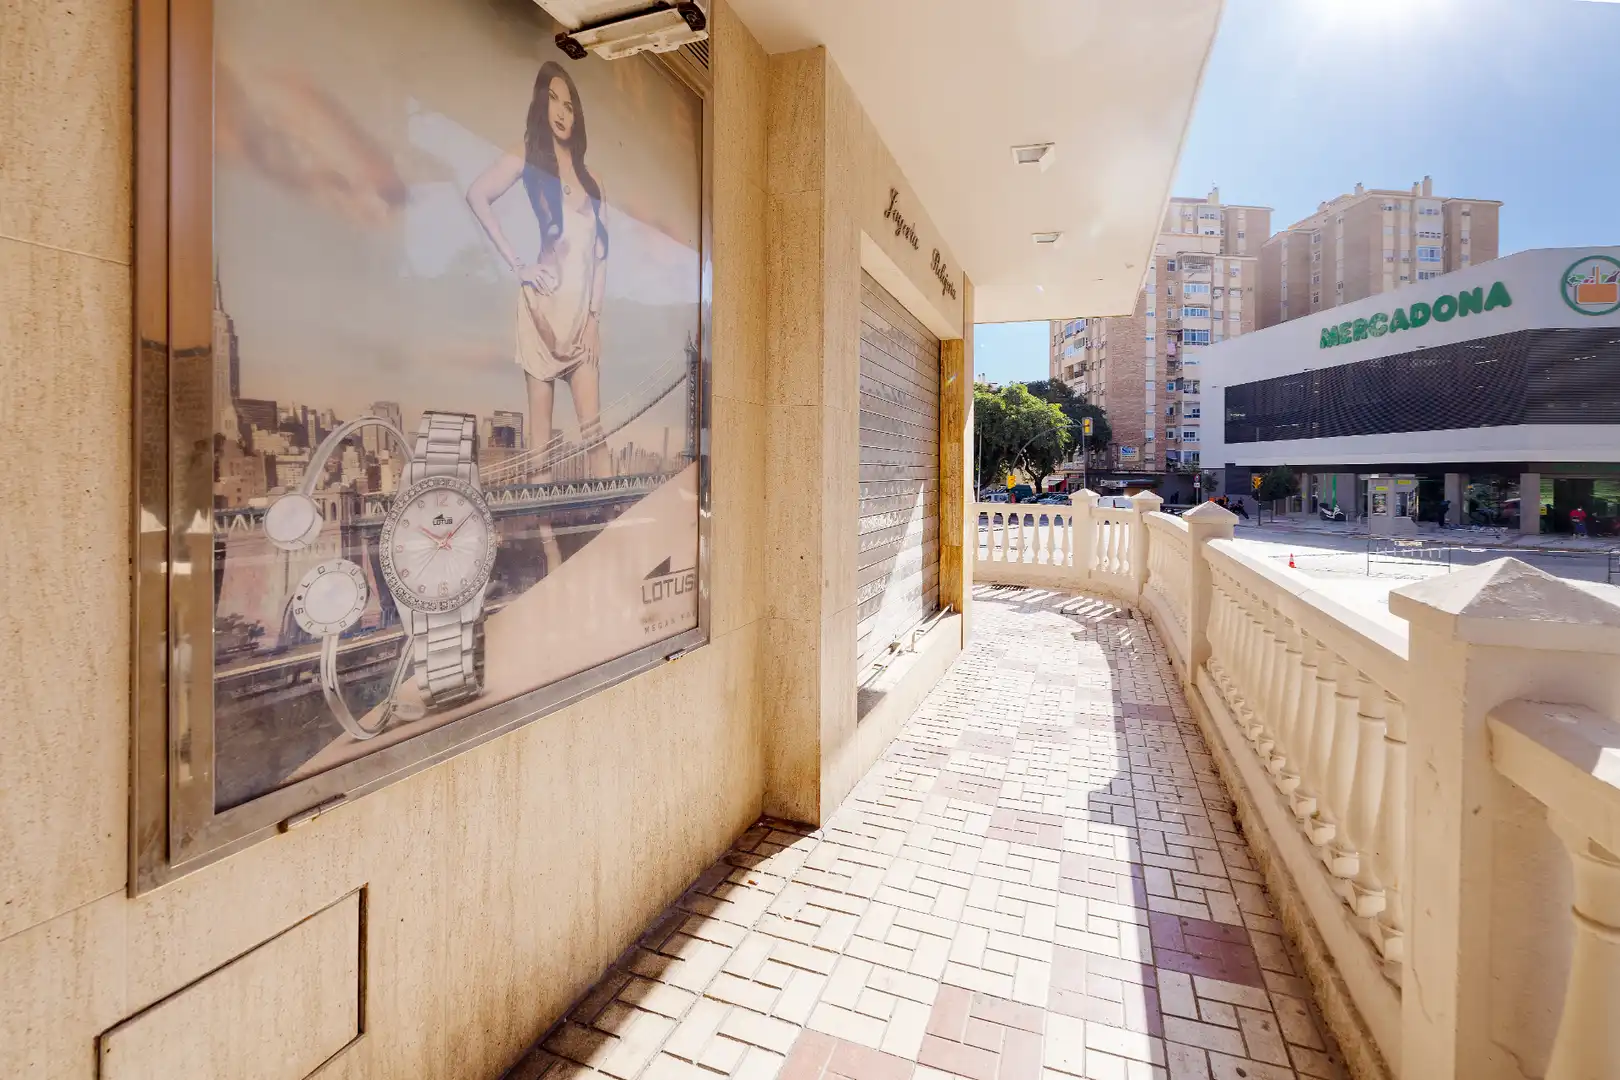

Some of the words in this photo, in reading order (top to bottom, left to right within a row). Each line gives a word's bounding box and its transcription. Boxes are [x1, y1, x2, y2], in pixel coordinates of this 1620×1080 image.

[1319, 281, 1512, 349] MERCADONA
[301, 562, 366, 590] LOTUS
[642, 573, 694, 605] LOTUS
